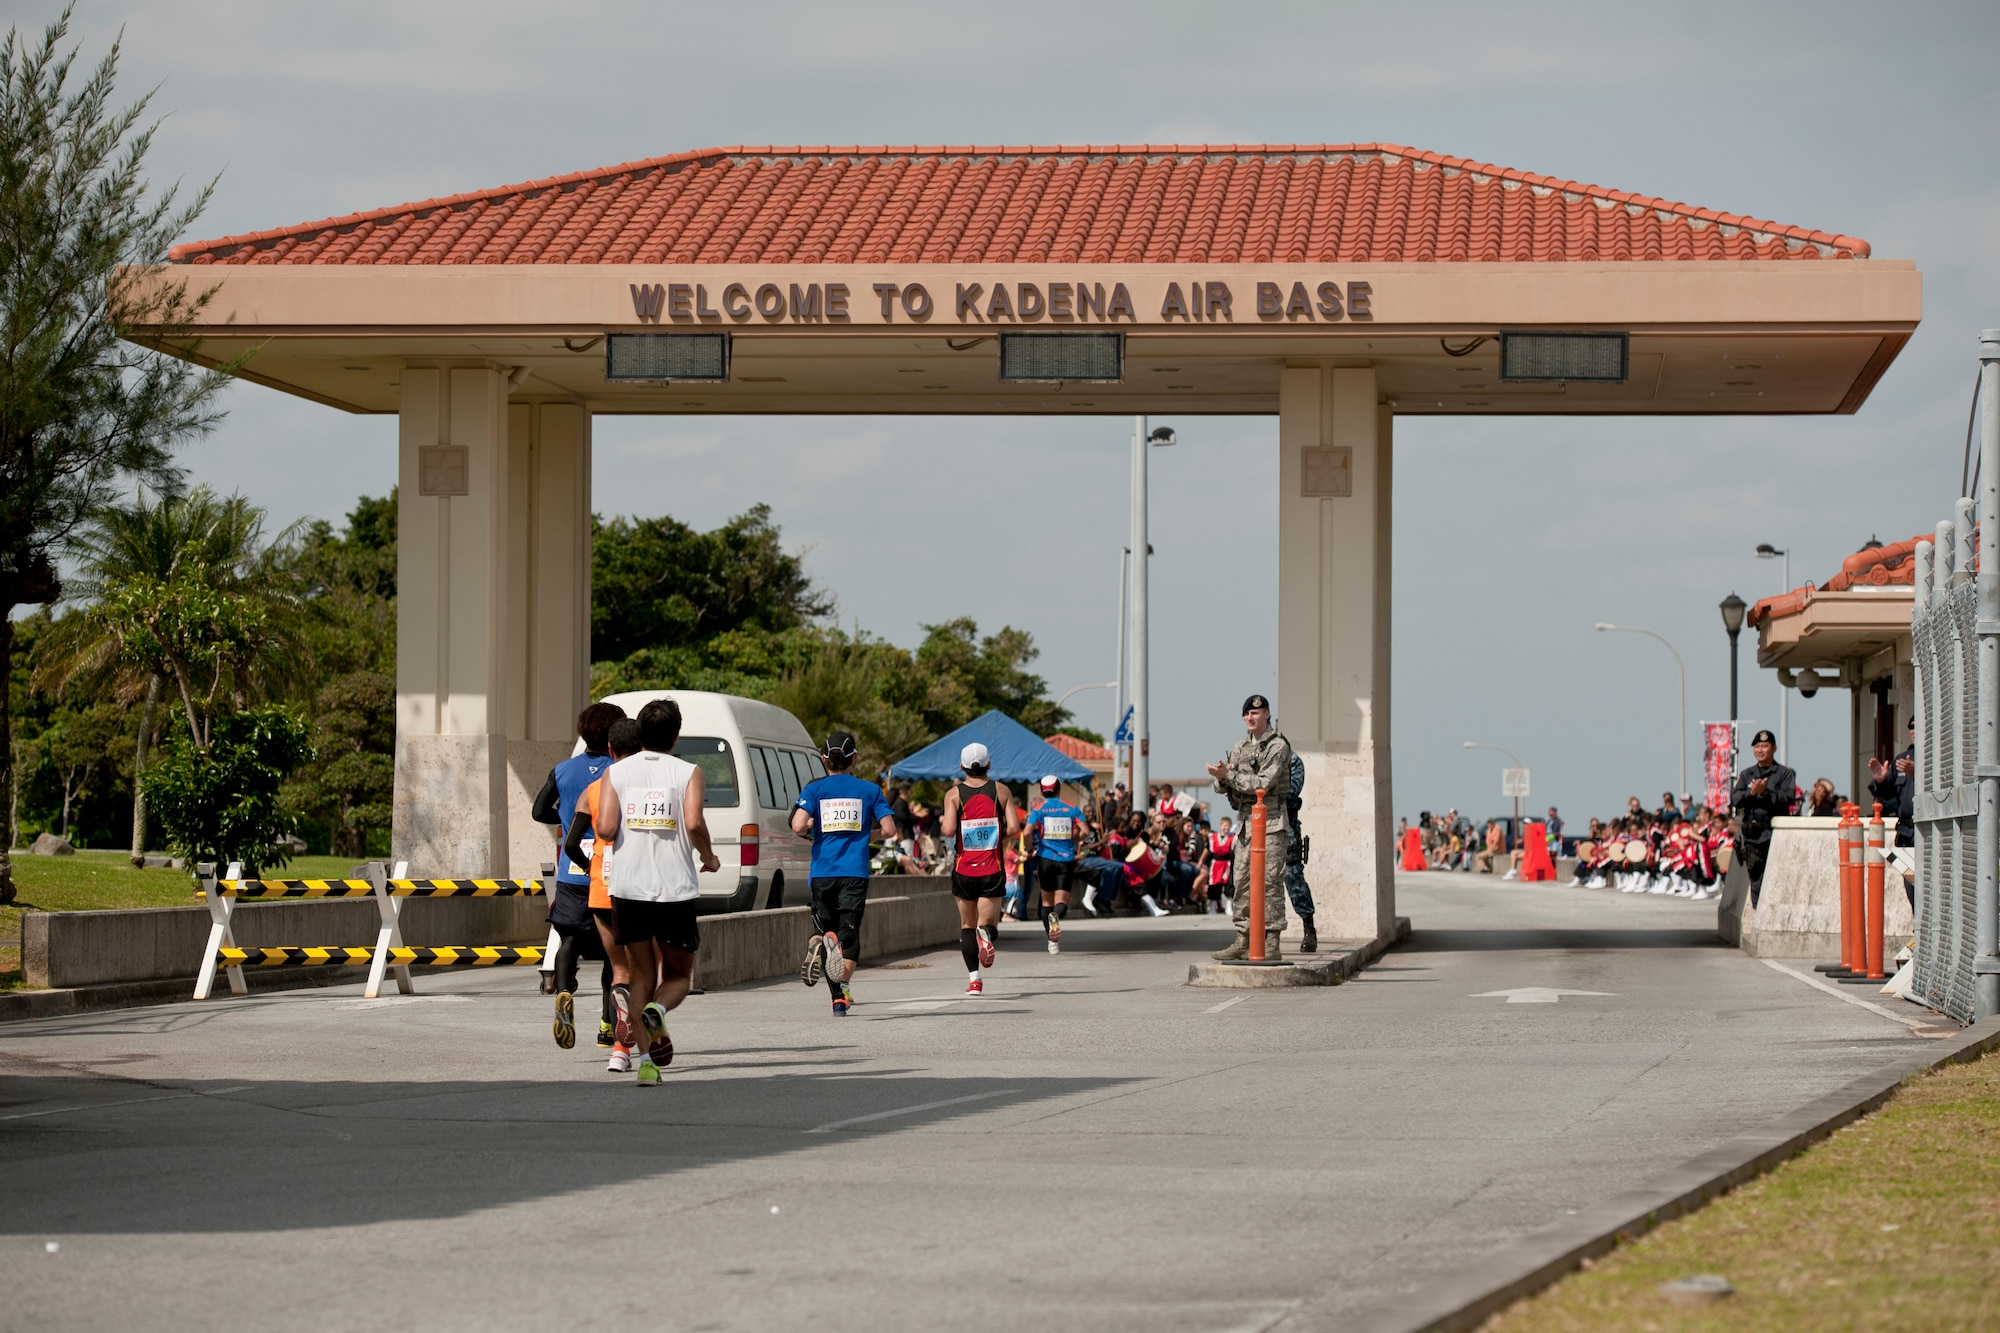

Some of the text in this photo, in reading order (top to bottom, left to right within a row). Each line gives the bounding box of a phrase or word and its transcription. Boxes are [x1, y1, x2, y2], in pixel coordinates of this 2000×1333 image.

[629, 281, 1373, 318] WELCOME TO KADENA AIR BASE
[627, 803, 672, 816] B 1341
[822, 810, 858, 821] C 2013
[964, 830, 989, 841] A 96
[604, 861, 611, 873] B
